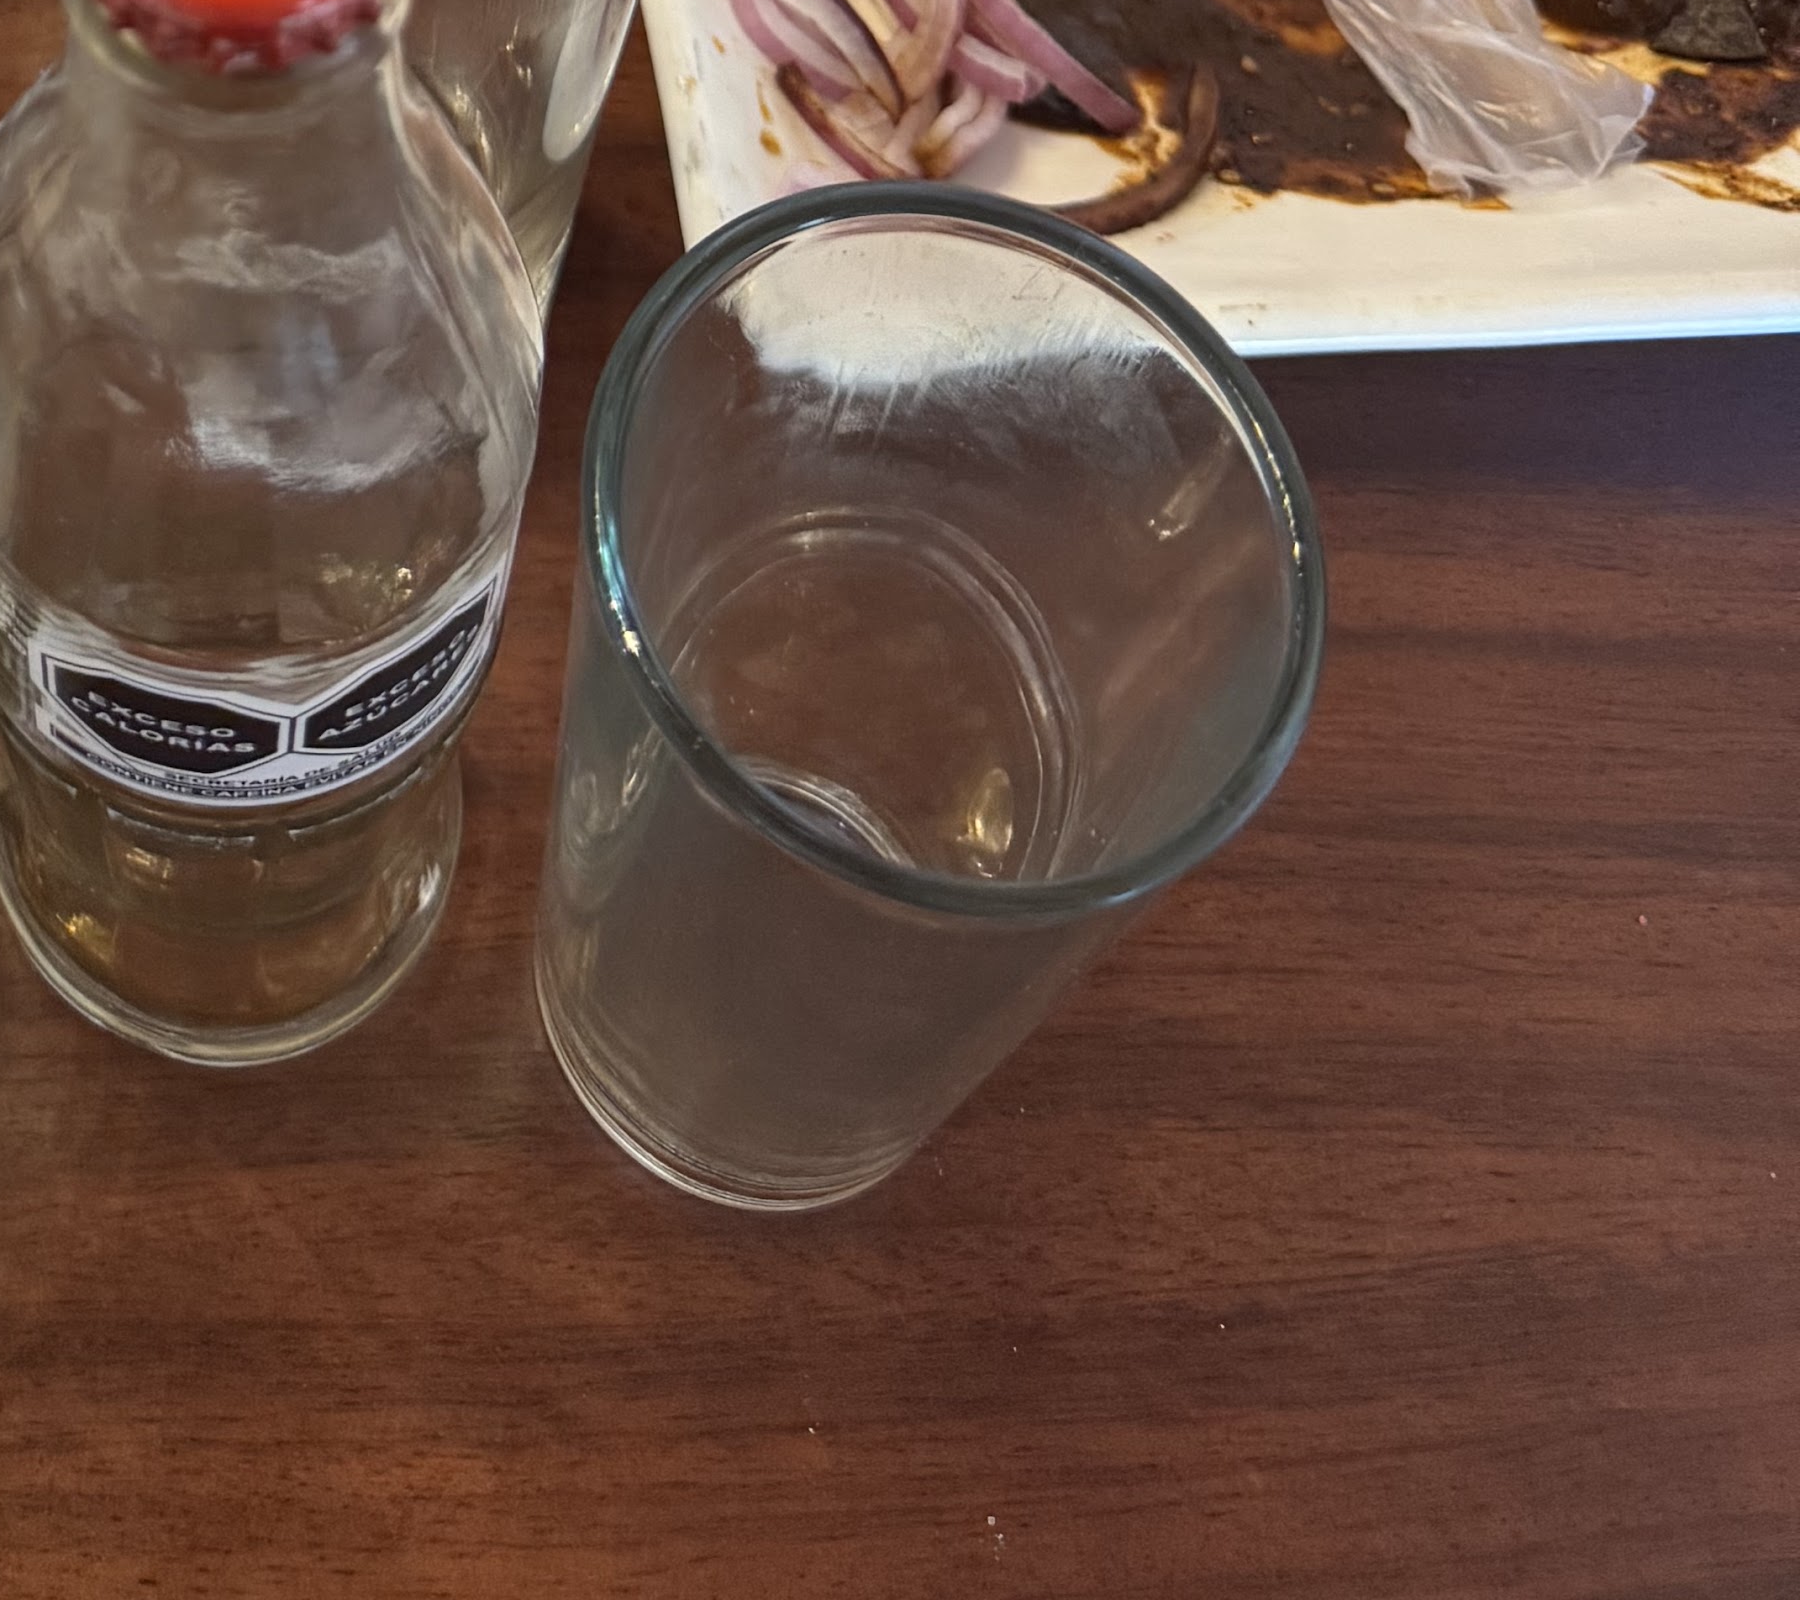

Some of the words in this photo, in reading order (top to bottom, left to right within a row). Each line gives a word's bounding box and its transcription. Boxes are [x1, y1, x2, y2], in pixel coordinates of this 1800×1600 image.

[344, 629, 466, 718] EXCESO
[71, 696, 256, 753] CALORÍAS
[88, 691, 236, 738] EXCESO
[86, 751, 194, 796] CONTIENE
[201, 779, 301, 799] CAFEÍNA
[305, 747, 387, 791] EVITAR
[163, 770, 300, 789] SECRETARÍA
[304, 765, 332, 780] DE
[338, 731, 402, 769] SALUD
